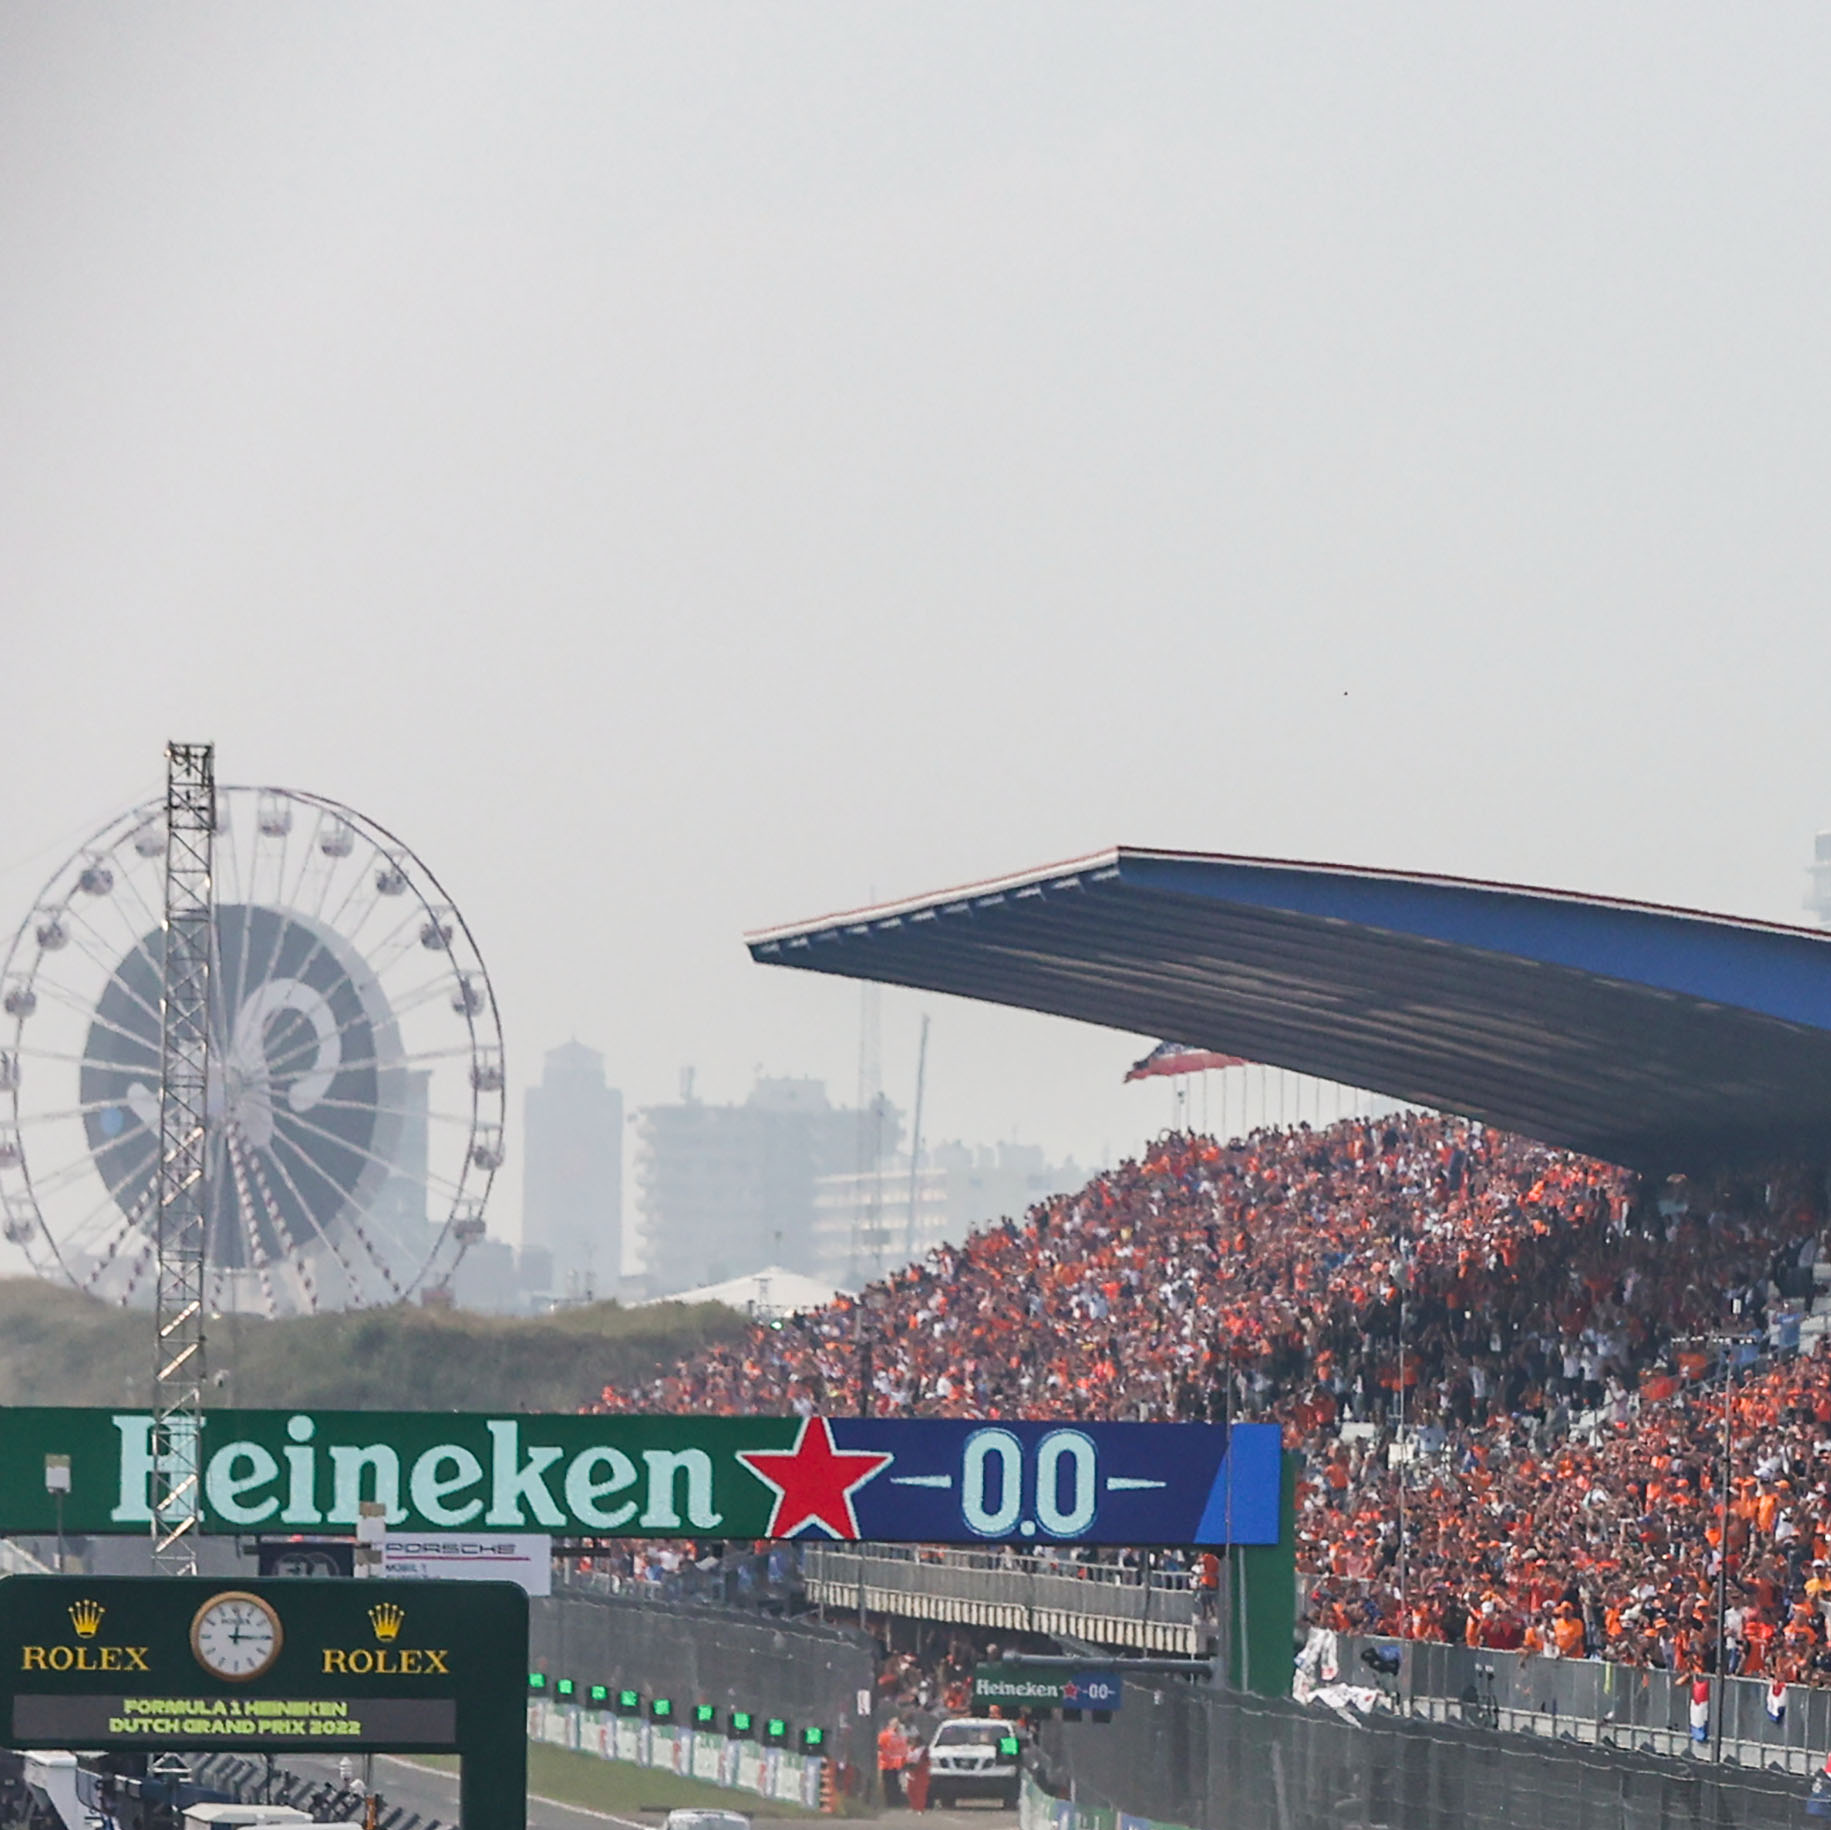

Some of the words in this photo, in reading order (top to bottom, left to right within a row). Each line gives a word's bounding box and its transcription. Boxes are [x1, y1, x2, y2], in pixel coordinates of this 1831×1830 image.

[112, 1415, 722, 1529] Heineken
[962, 1427, 1099, 1538] 0.0
[385, 1542, 516, 1554] PORSCHE
[21, 1646, 150, 1671] ROLEX
[322, 1649, 450, 1674] ROLEX
[976, 1679, 1058, 1698] Heineken
[124, 1700, 225, 1716] FORMULA
[230, 1701, 243, 1716] 1
[109, 1718, 181, 1735] DUTCH
[183, 1718, 256, 1735] GRAND
[258, 1719, 306, 1735] PRIX
[309, 1719, 361, 1736] 2022
